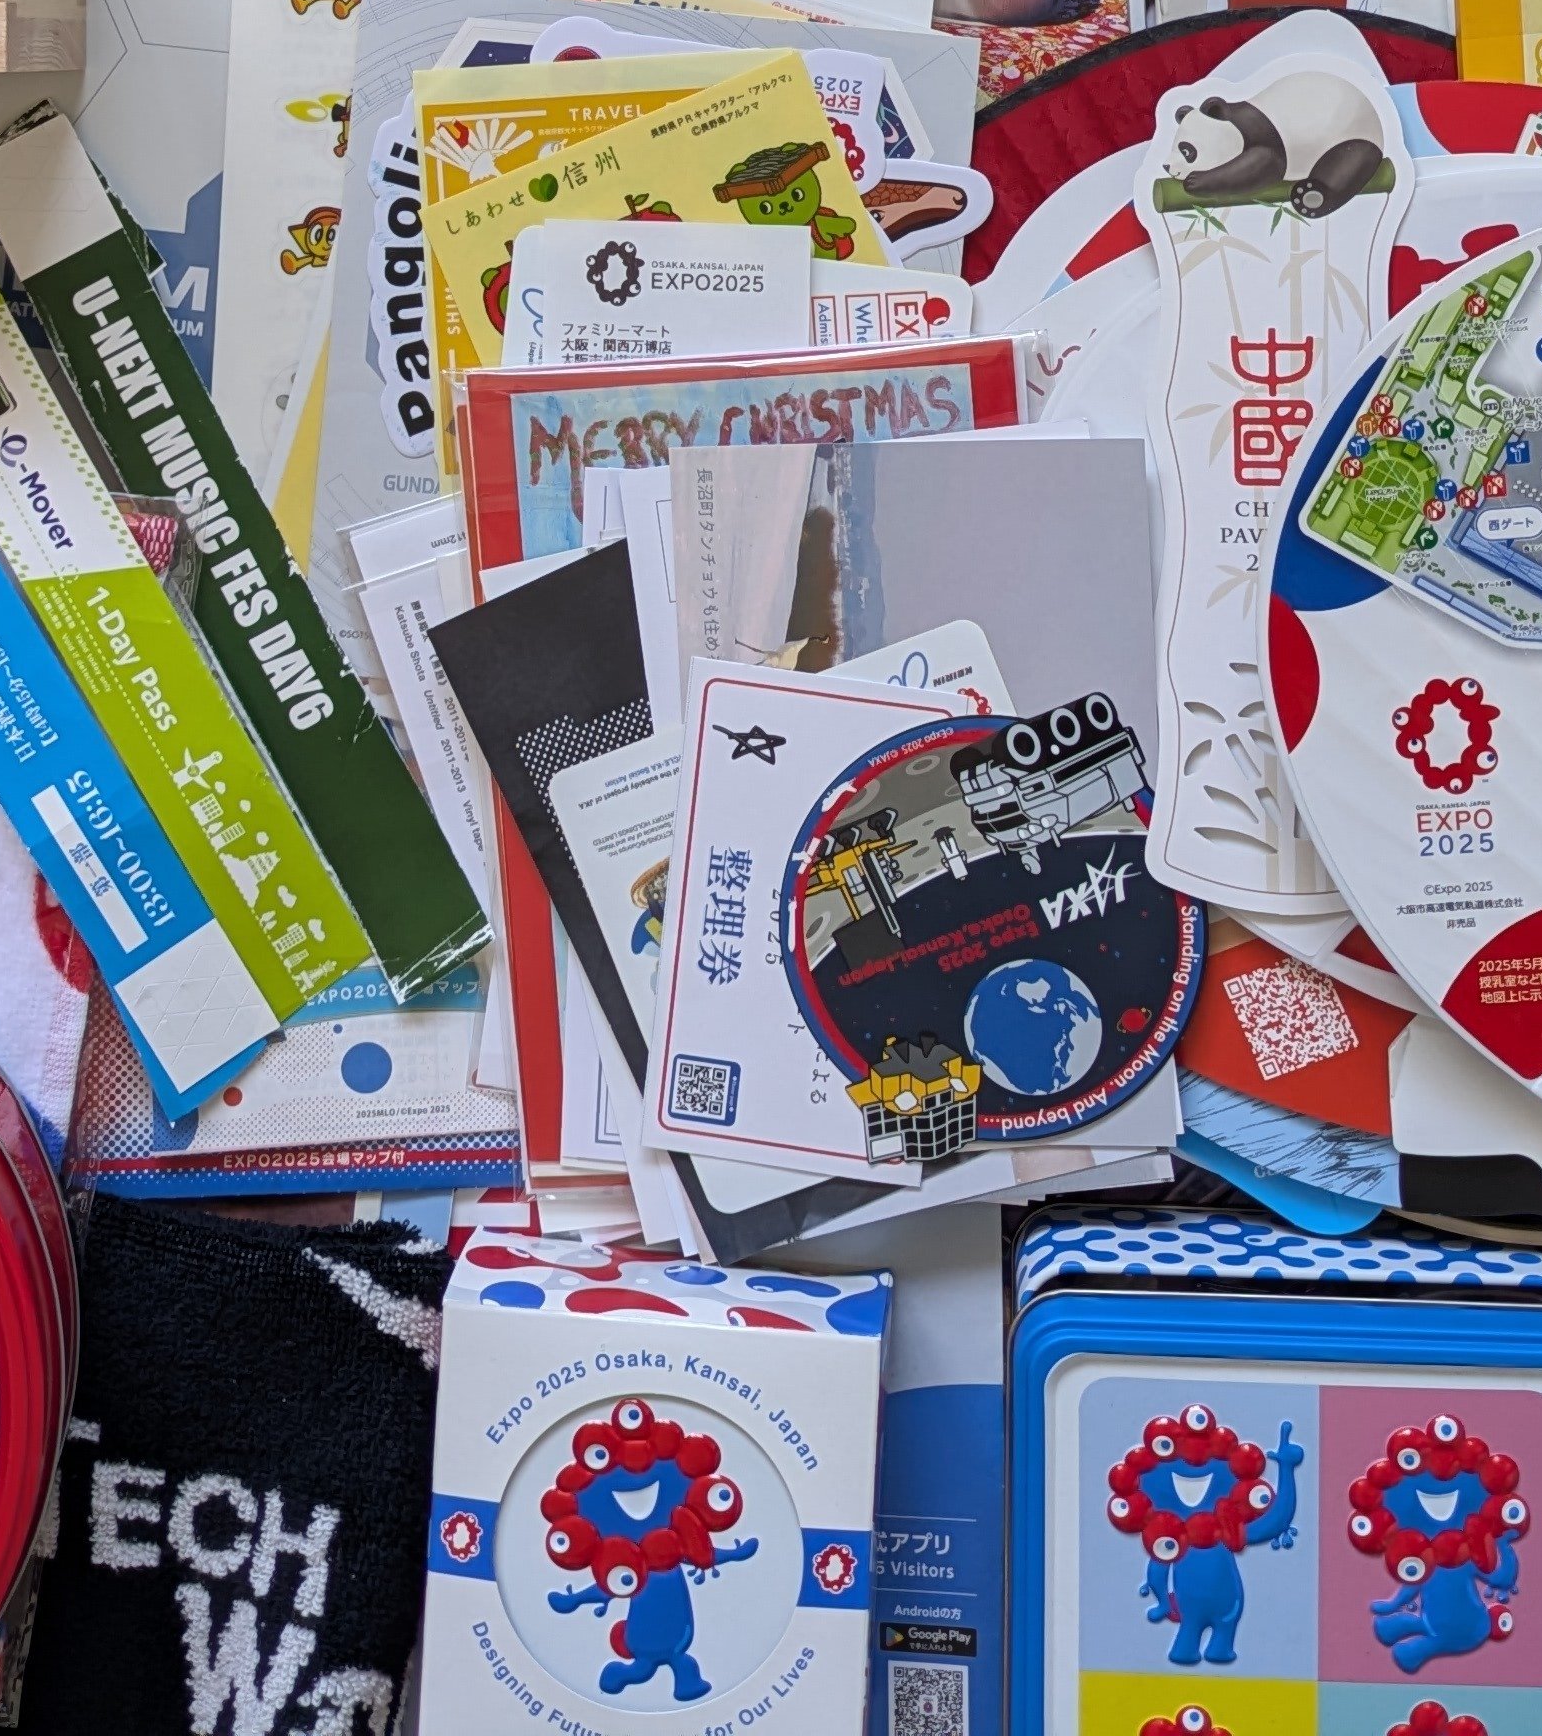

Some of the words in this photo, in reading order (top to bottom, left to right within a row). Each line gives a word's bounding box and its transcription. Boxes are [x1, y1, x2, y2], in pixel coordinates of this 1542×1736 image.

[568, 103, 646, 122] TRAVEL
[445, 190, 525, 235] しあわせ
[561, 144, 620, 191] 信州
[650, 271, 765, 293] EXPO2025
[560, 322, 671, 338] ファミリーマート
[71, 275, 175, 421] U-NEXT
[140, 414, 242, 558] MUSIC
[210, 552, 277, 638] FES
[247, 635, 335, 732] DAY6
[84, 585, 143, 672] 1-Day
[130, 671, 179, 733] Pass
[1416, 807, 1494, 834] EXPO
[1419, 832, 1496, 857] 2025
[1039, 841, 1142, 930] JAXA
[1423, 882, 1462, 897] ©Expo
[1464, 880, 1494, 894] 2025
[1179, 902, 1200, 990] Standing
[1171, 989, 1185, 1013] on
[1153, 1011, 1179, 1045] the
[1107, 1043, 1161, 1091] Moon.
[1071, 1085, 1109, 1117] And
[222, 1148, 407, 1169] EXPO2025会場マップ付
[890, 1560, 955, 1580] Visitors
[893, 1603, 962, 1620] Androidの方
[907, 1627, 944, 1643] Google
[946, 1629, 971, 1646] Play
[471, 1620, 545, 1717] Designing
[737, 1692, 776, 1725] Our
[775, 1644, 816, 1699] Lives
